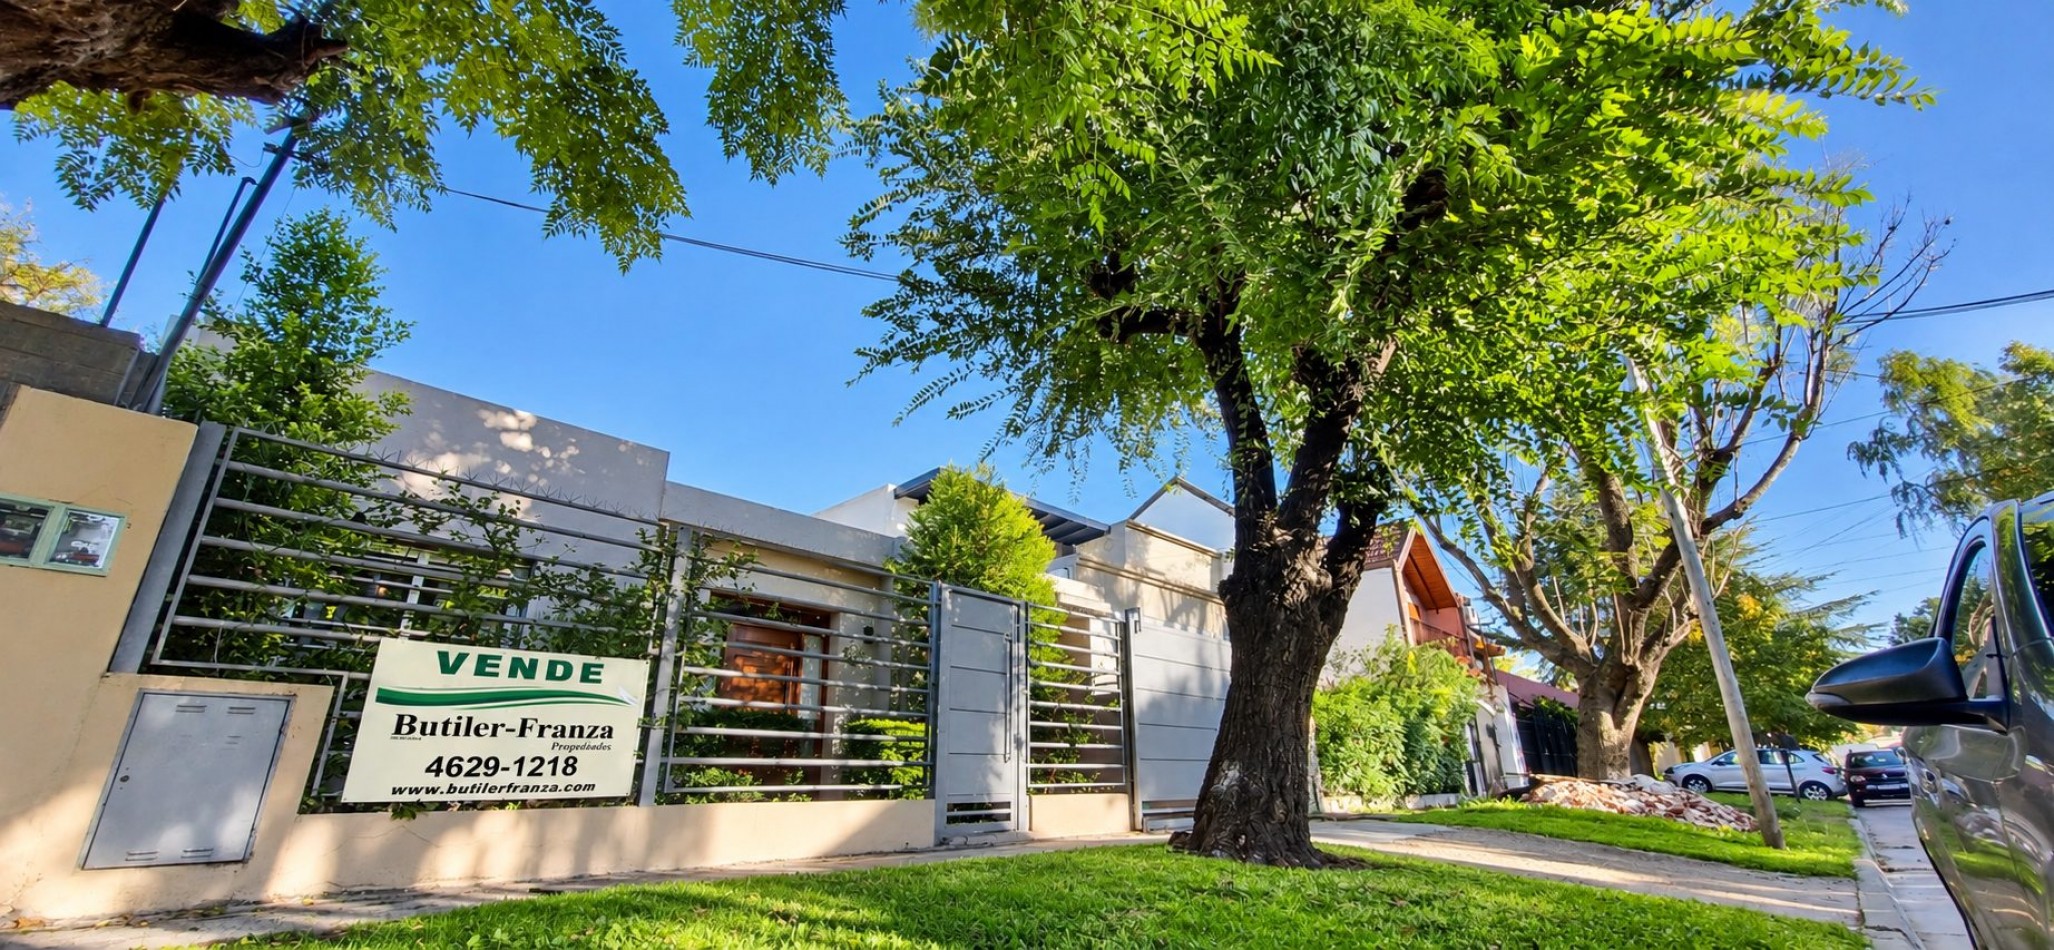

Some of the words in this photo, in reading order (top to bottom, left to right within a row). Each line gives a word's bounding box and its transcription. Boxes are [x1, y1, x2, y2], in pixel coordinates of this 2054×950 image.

[437, 651, 604, 684] VENDE
[391, 713, 614, 740] Butiler-Franza
[425, 756, 578, 777] 4629-1218
[391, 783, 596, 795] www.butilerfranza.com
